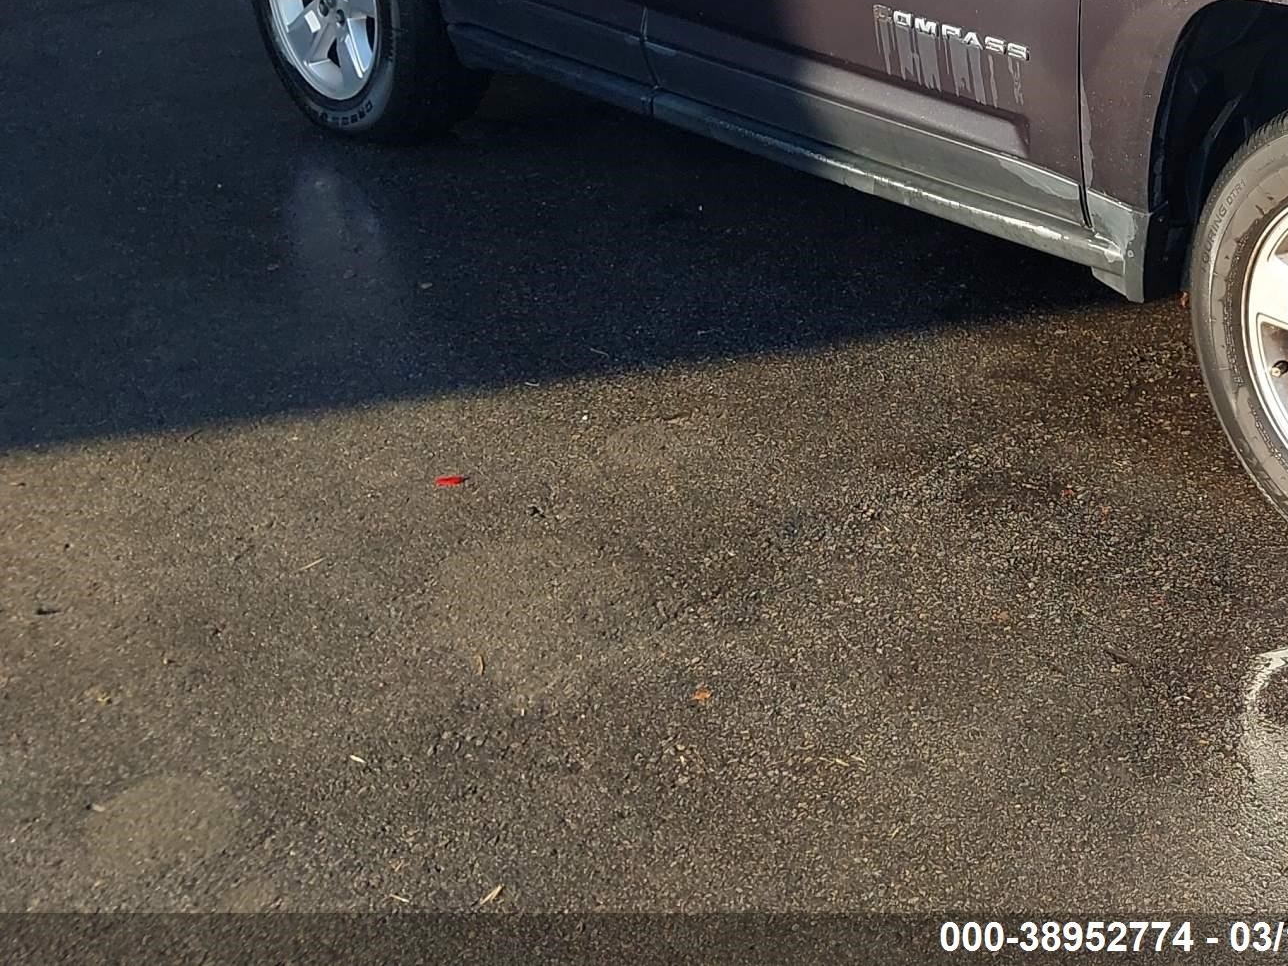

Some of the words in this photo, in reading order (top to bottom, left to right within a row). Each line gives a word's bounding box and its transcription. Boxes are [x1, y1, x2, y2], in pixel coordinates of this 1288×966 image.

[872, 4, 1031, 61] COMPASS
[1199, 203, 1228, 275] TOURING
[1226, 177, 1248, 207] DTR1
